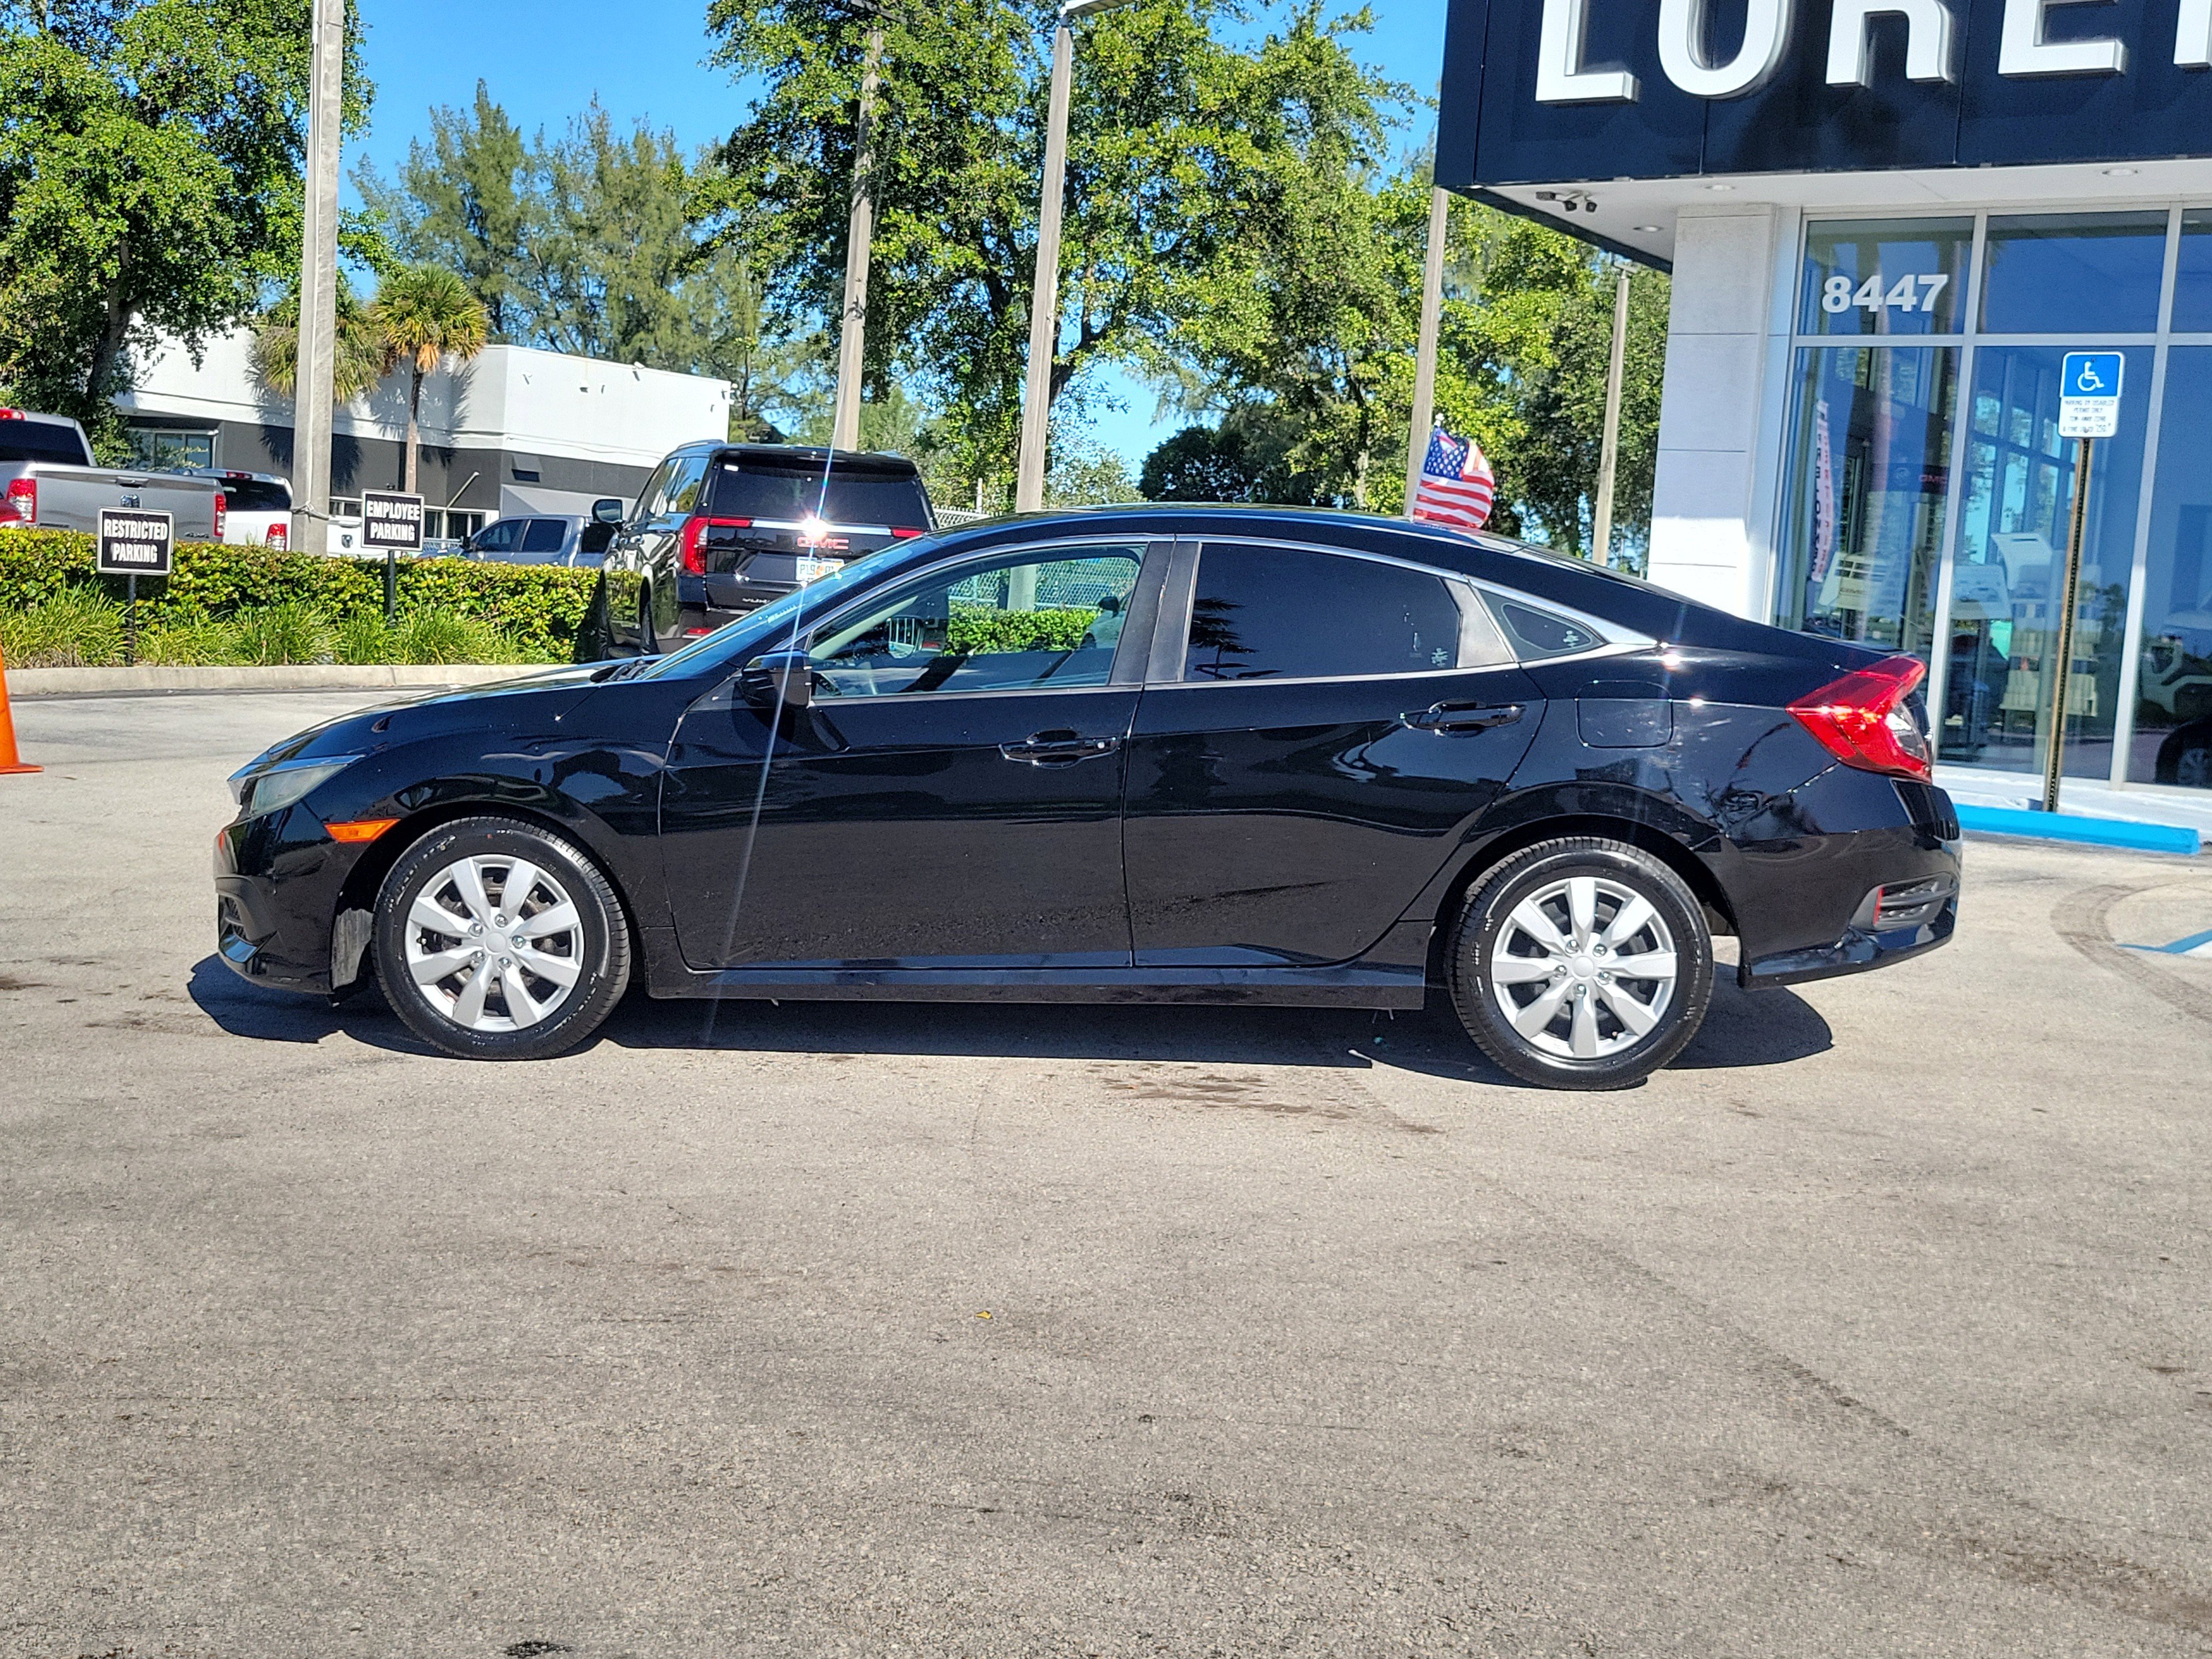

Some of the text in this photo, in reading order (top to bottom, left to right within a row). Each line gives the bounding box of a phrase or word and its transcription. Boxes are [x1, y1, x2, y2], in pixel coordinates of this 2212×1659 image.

[1822, 274, 1949, 313] 8447
[366, 500, 420, 521] EMPLOYEE
[103, 518, 168, 540] RESTRICTED
[370, 522, 415, 541] PARKING
[111, 542, 158, 563] PARKING
[797, 537, 849, 550] GMC
